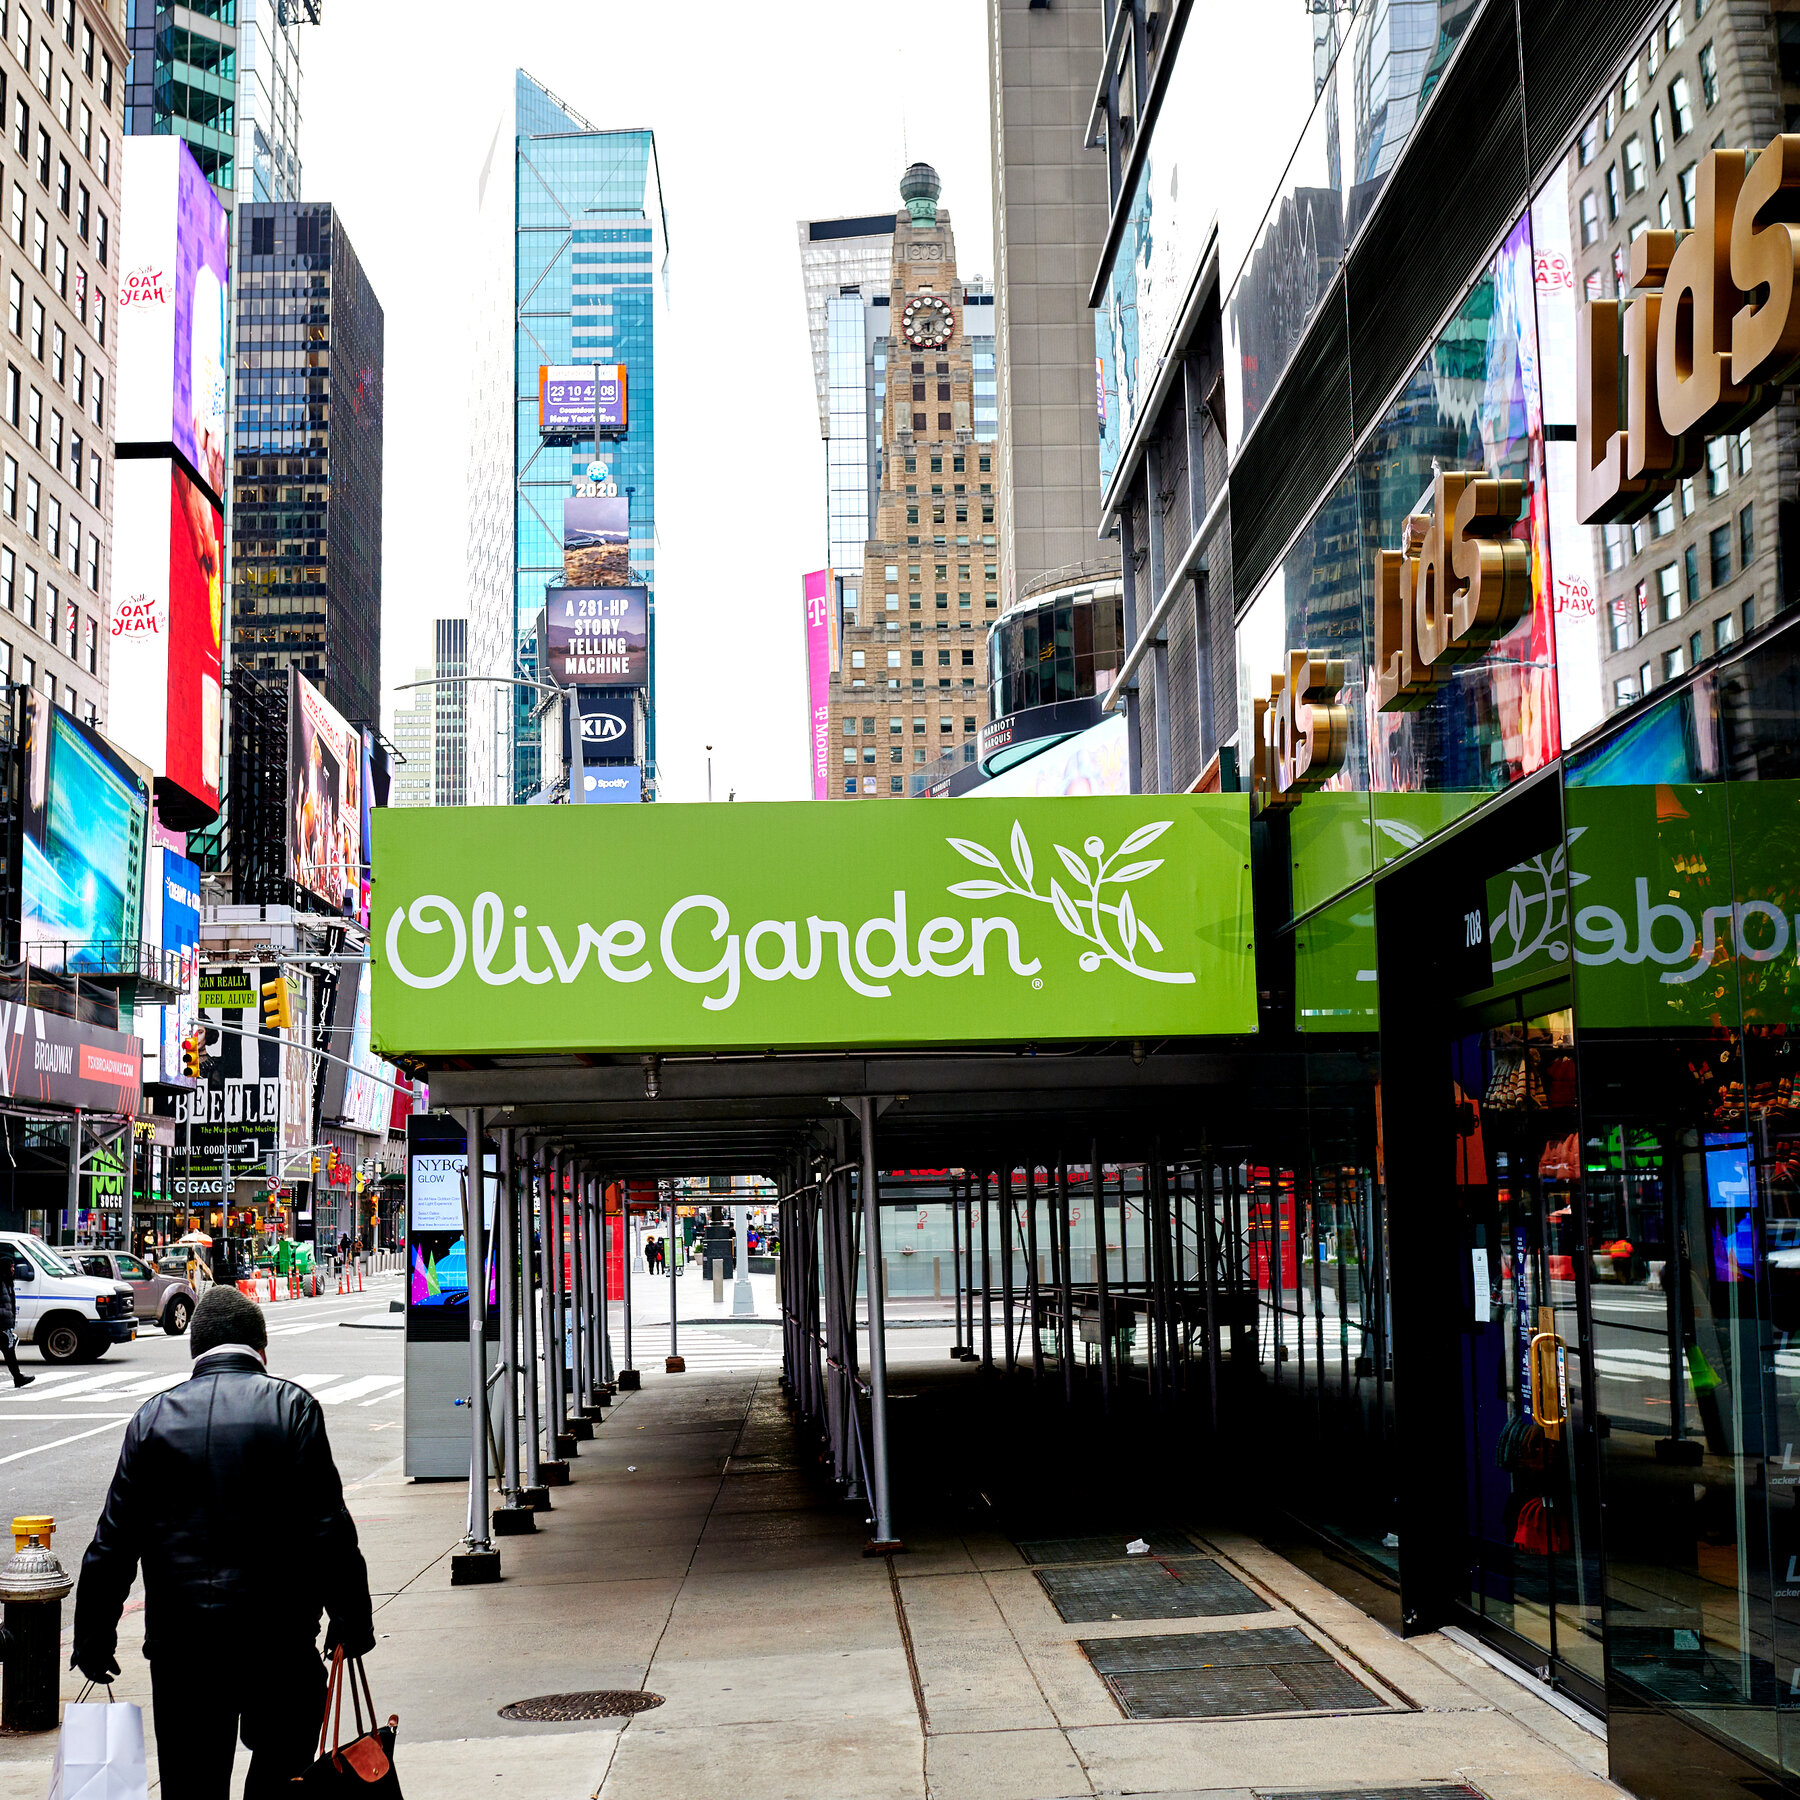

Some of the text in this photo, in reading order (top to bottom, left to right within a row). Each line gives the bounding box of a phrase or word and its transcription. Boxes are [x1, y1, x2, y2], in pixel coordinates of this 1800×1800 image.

[129, 271, 162, 288] OAT
[120, 287, 166, 305] YEAH
[1577, 133, 1800, 525] Lids
[551, 386, 565, 397] 23
[567, 386, 581, 396] 10
[575, 483, 618, 498] 2020
[1374, 472, 1518, 710] Lids
[121, 600, 155, 617] OAT
[565, 600, 629, 617] A 281-HP
[112, 616, 159, 636] YEAH
[574, 618, 620, 636] STORY
[568, 638, 626, 655] TELLING
[565, 657, 630, 675] MACHINE
[581, 719, 617, 736] KIA
[983, 717, 1016, 738] MARRIOTT
[1250, 649, 1338, 820] Lids
[815, 722, 828, 777] Mobile
[984, 732, 1011, 750] MARQUIS
[598, 778, 629, 789] Spotify
[1464, 909, 1482, 947] 708
[385, 891, 654, 990] Olive
[660, 890, 1042, 1011] Garden
[199, 975, 247, 988] CAN REALLY
[205, 993, 254, 1005] FEEL ALIVE!
[34, 1041, 73, 1074] BROADWAY
[87, 1055, 134, 1077] TSXBROADWAY.COM
[175, 1078, 278, 1123] BEETLE
[201, 1126, 212, 1134] The
[242, 1126, 253, 1134] The
[204, 1145, 225, 1155] GOOD
[417, 1159, 463, 1171] NYBG
[174, 1180, 236, 1193] GGAGE
[418, 1175, 445, 1183] GLOW
[101, 1195, 122, 1208] SOCCE
[919, 1210, 928, 1223] 2
[971, 1210, 980, 1222] 3
[1072, 1208, 1081, 1220] 5
[1769, 1476, 1797, 1485] ocker
[1775, 1587, 1800, 1598] ocker
